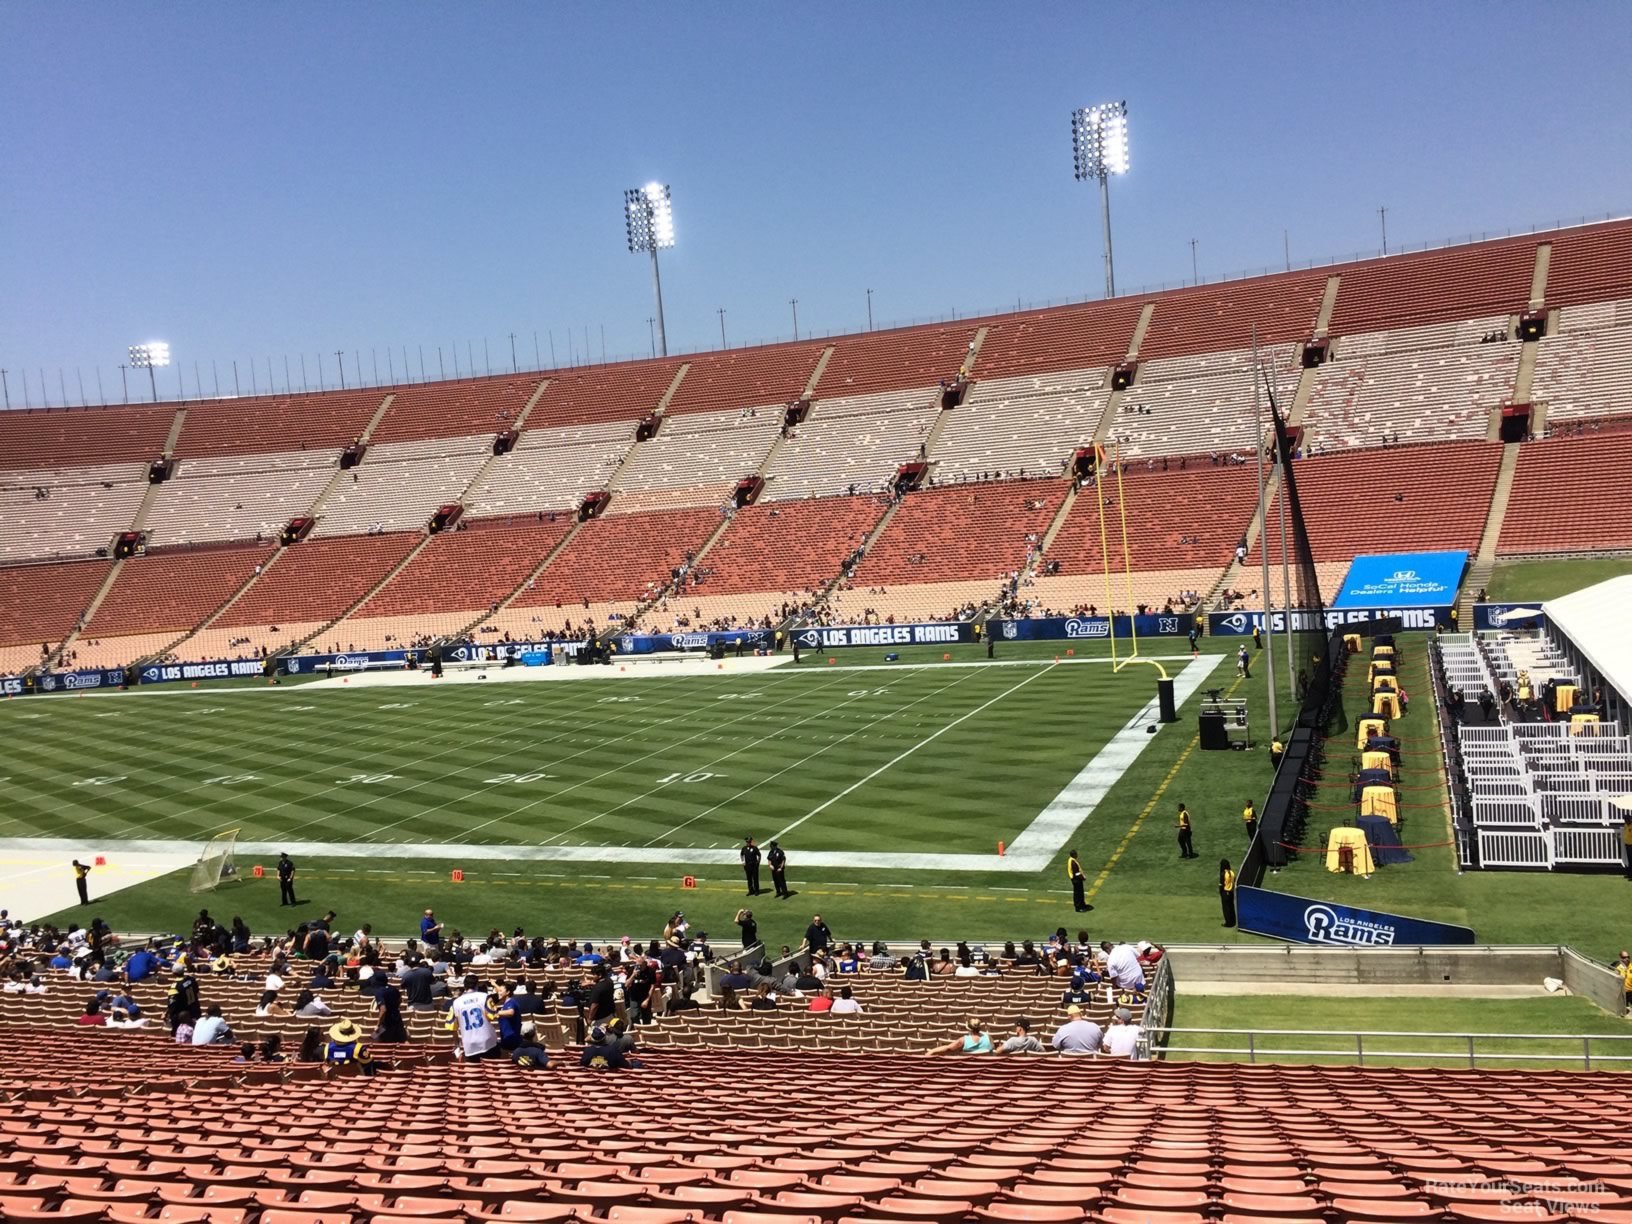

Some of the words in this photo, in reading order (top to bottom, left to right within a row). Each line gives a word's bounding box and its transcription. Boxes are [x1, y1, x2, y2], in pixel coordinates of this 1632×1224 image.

[1065, 618, 1110, 637] Rams
[672, 634, 708, 647] Rams
[823, 630, 847, 646] LOS
[851, 626, 910, 644] ANGELES
[915, 625, 959, 642] RAMS
[161, 666, 181, 680] LOS
[183, 663, 228, 678] ANGELES
[231, 661, 264, 674] RAMS
[64, 673, 101, 689] Rams
[336, 774, 394, 783] 30
[482, 773, 547, 783] 20
[656, 772, 715, 783] 10
[453, 871, 461, 881] 10
[685, 877, 693, 887] G
[1304, 905, 1395, 945] Rams
[1356, 920, 1395, 932] ANGELES
[462, 1008, 484, 1031] 13
